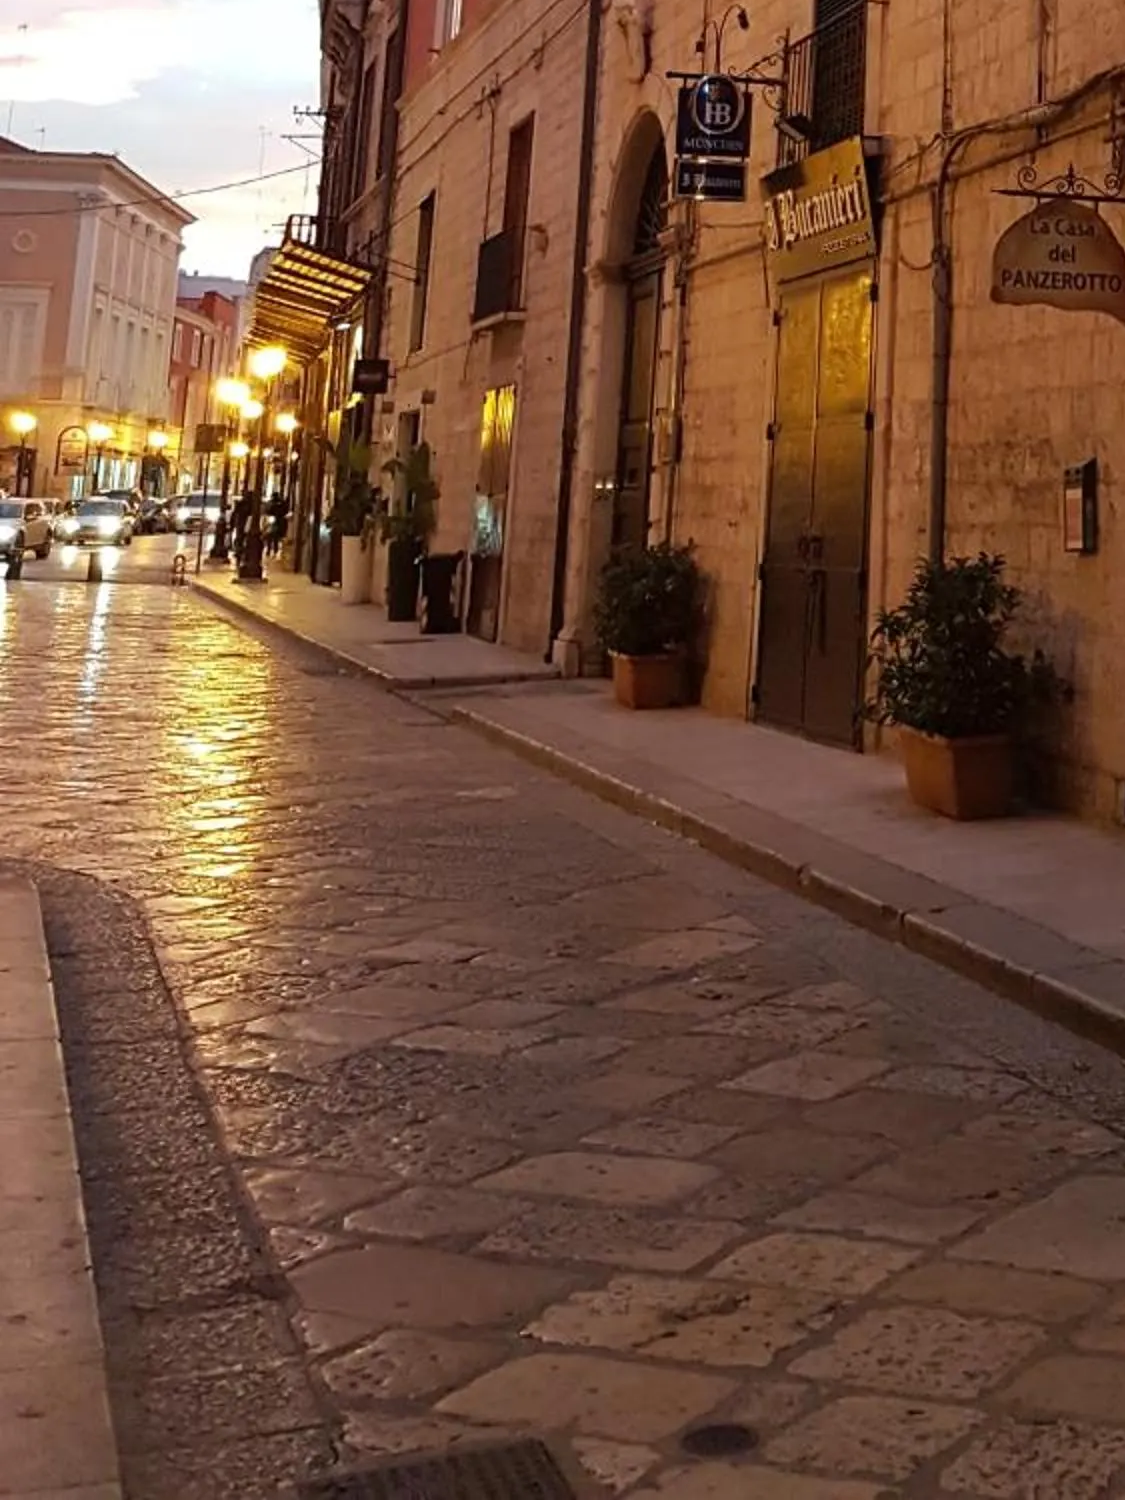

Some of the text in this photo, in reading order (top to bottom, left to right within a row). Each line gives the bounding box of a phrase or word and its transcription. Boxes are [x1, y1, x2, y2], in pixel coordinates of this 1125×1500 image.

[704, 102, 731, 125] HB
[778, 165, 866, 248] Bucanieri
[1030, 218, 1096, 237] La Casa
[1048, 244, 1076, 263] del
[1001, 268, 1122, 293] PANZEROTTO
